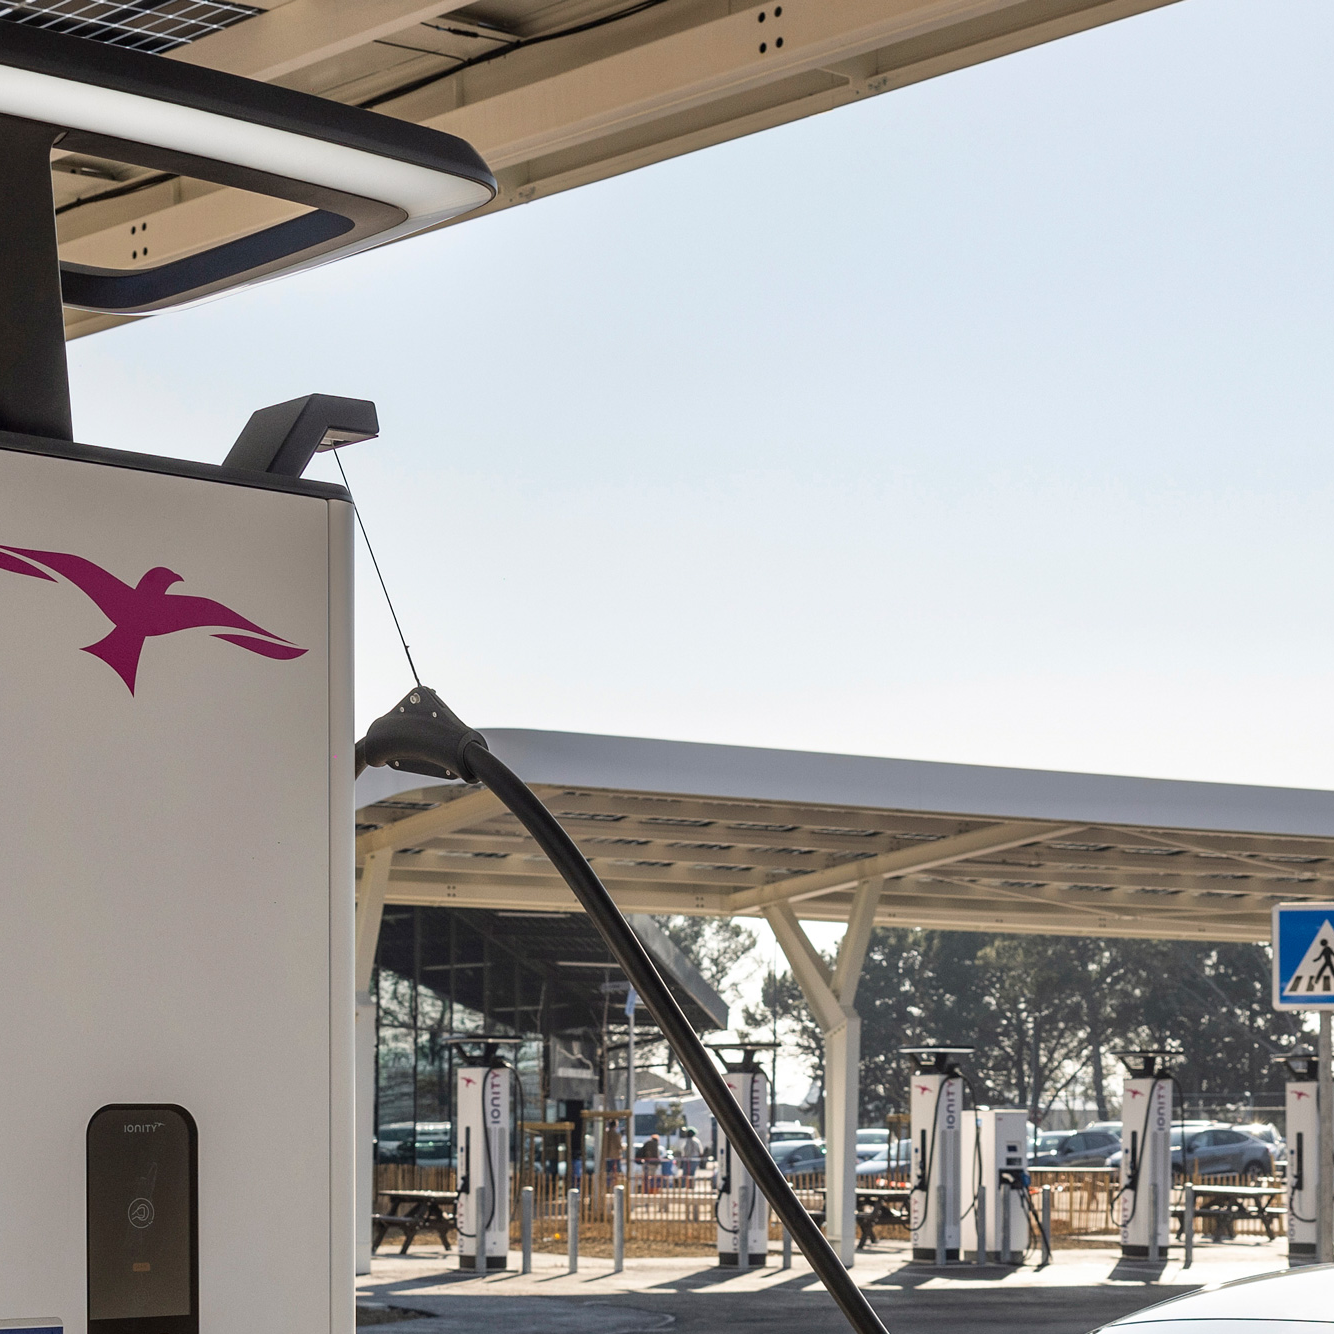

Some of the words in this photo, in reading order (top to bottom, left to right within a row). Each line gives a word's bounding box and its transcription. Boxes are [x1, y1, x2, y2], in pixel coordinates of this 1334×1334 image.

[490, 1069, 501, 1124] IONITY
[946, 1079, 955, 1130] IONITY
[1156, 1083, 1165, 1131] IONITY
[123, 1123, 157, 1133] IONITY
